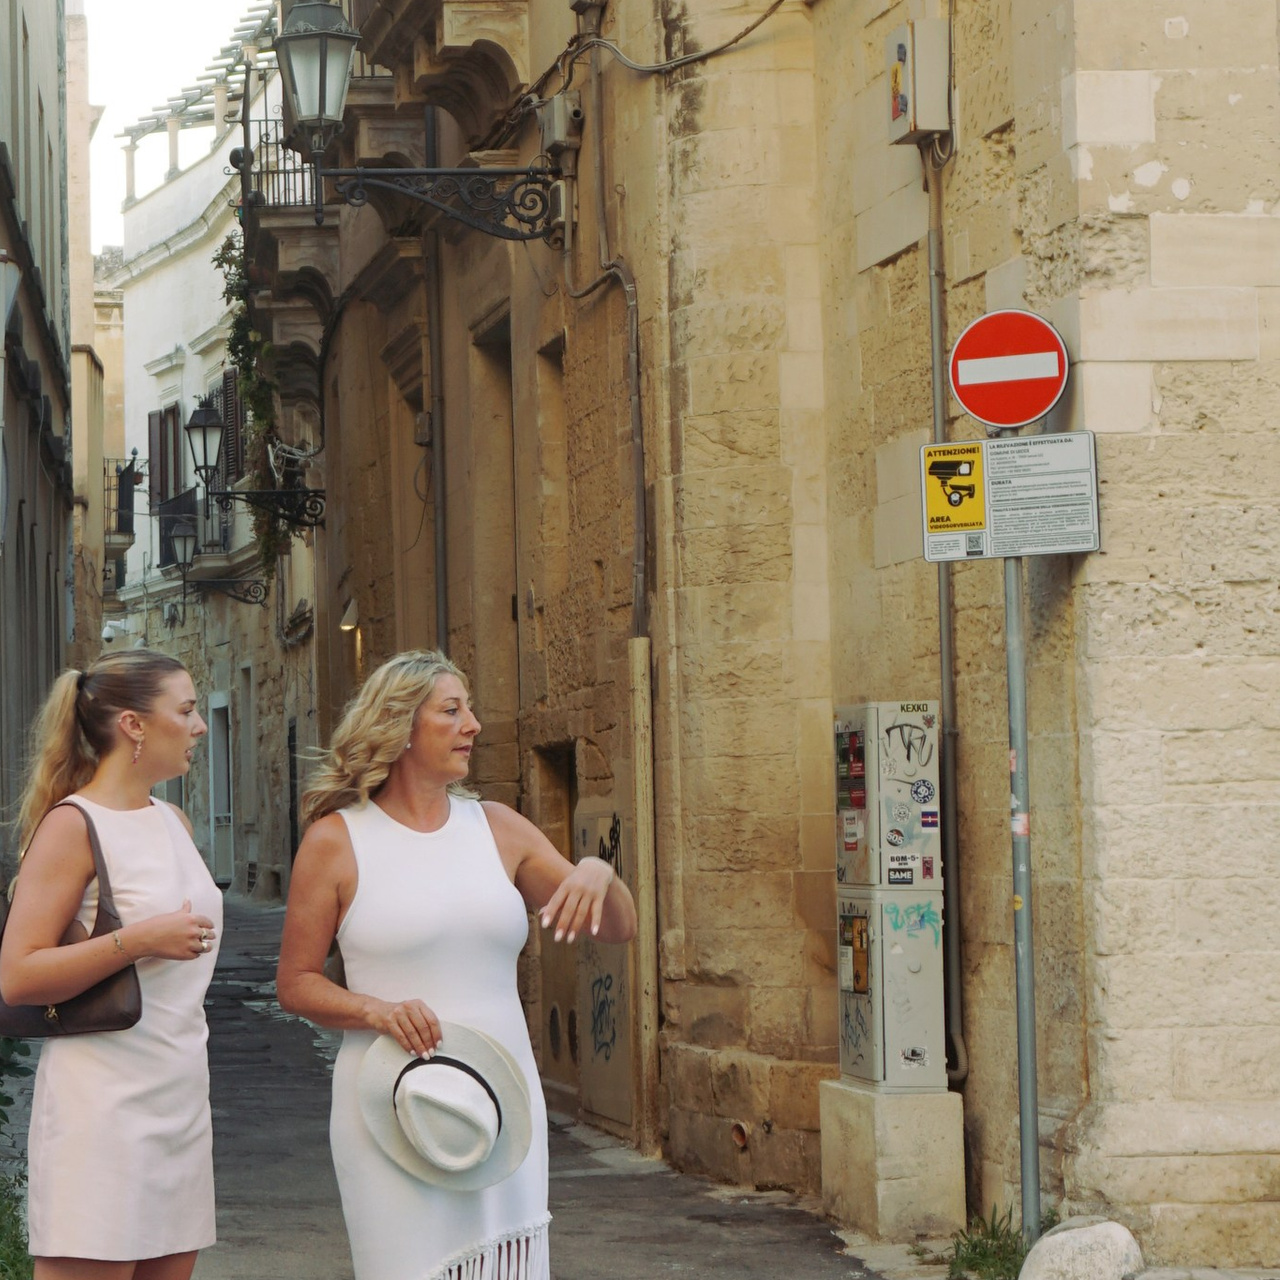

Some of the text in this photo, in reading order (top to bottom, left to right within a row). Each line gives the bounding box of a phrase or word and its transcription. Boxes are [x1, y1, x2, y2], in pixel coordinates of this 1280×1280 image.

[927, 447, 980, 458] ATTENZIONE!
[930, 515, 951, 523] AREA
[929, 521, 983, 529] VIDEOSORVEGLIATA
[886, 832, 904, 844] 505
[889, 871, 912, 879] SAME
